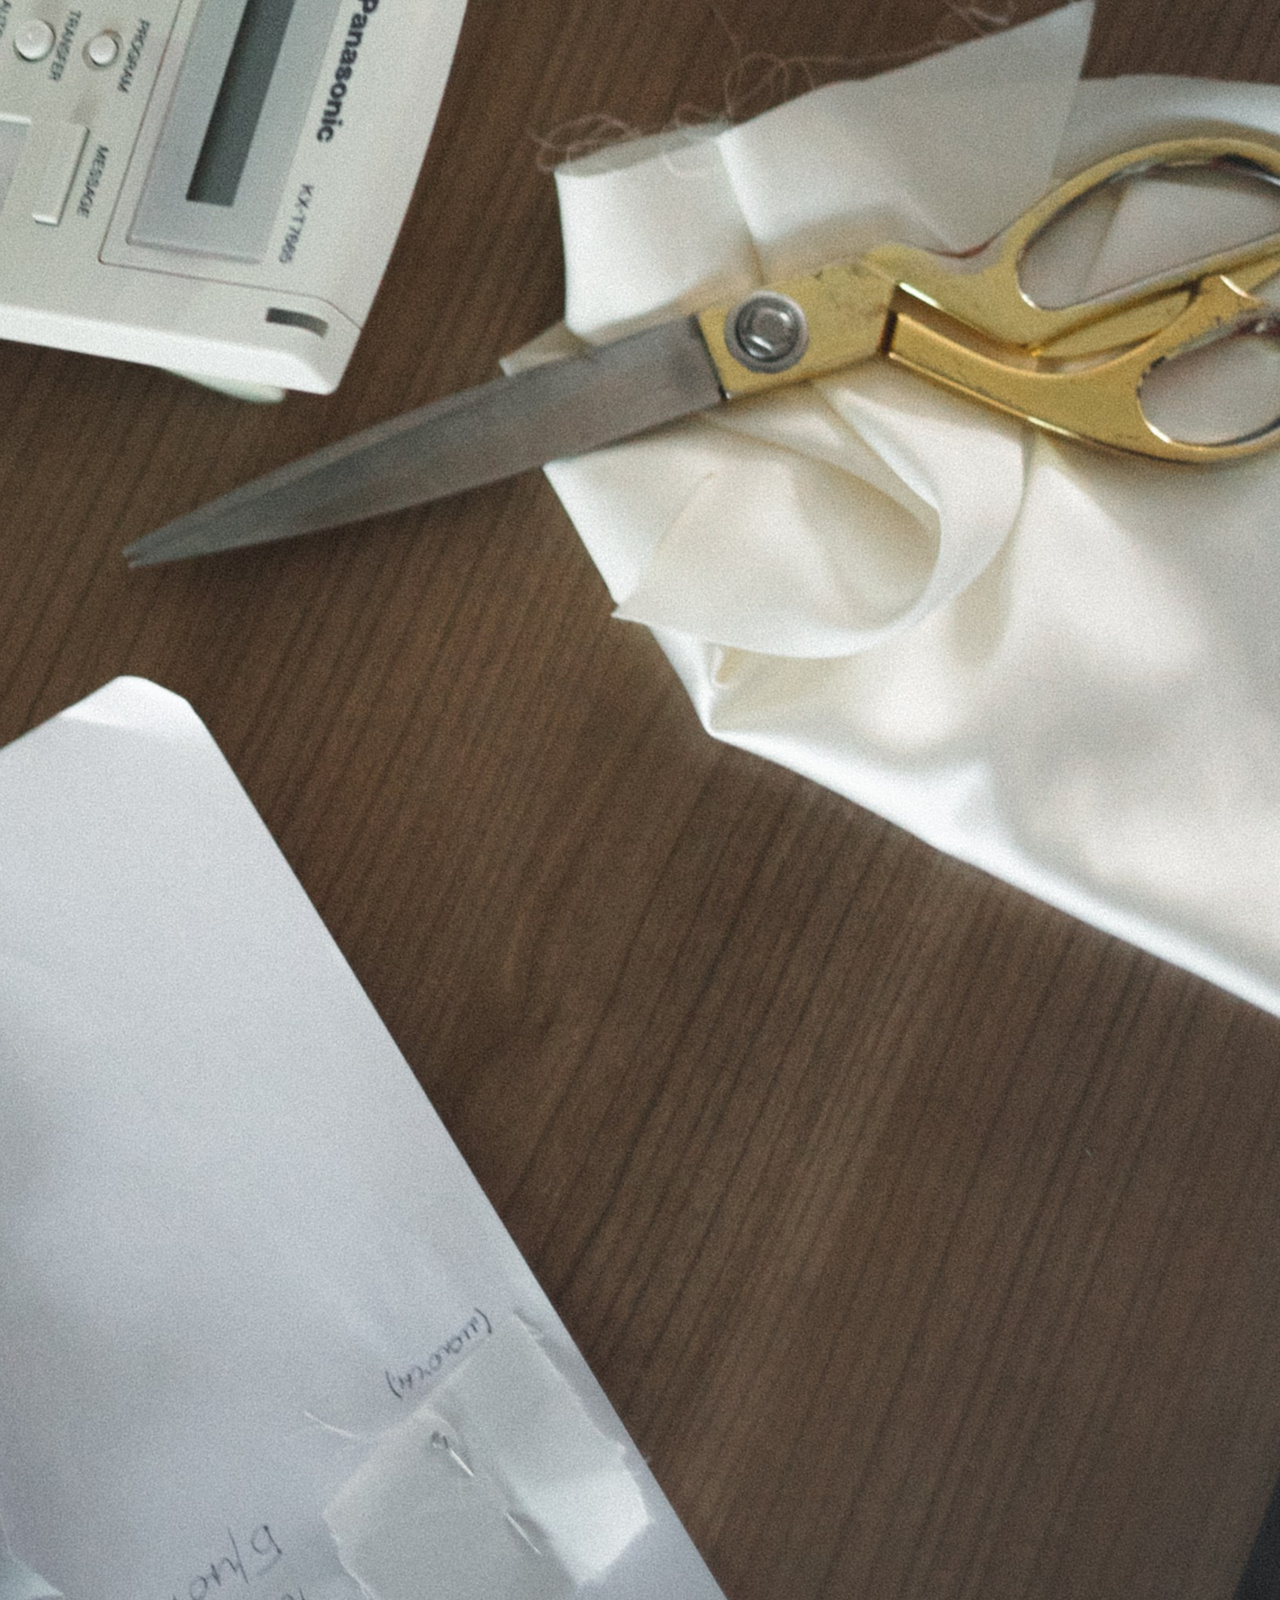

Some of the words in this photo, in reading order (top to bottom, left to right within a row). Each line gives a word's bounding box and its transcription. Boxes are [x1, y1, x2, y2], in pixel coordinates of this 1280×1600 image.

[47, 8, 82, 83] TRANSFER
[115, 17, 150, 93] PROGRAM
[75, 145, 109, 219] MESSAGE
[172, 1515, 282, 1600] Брю
